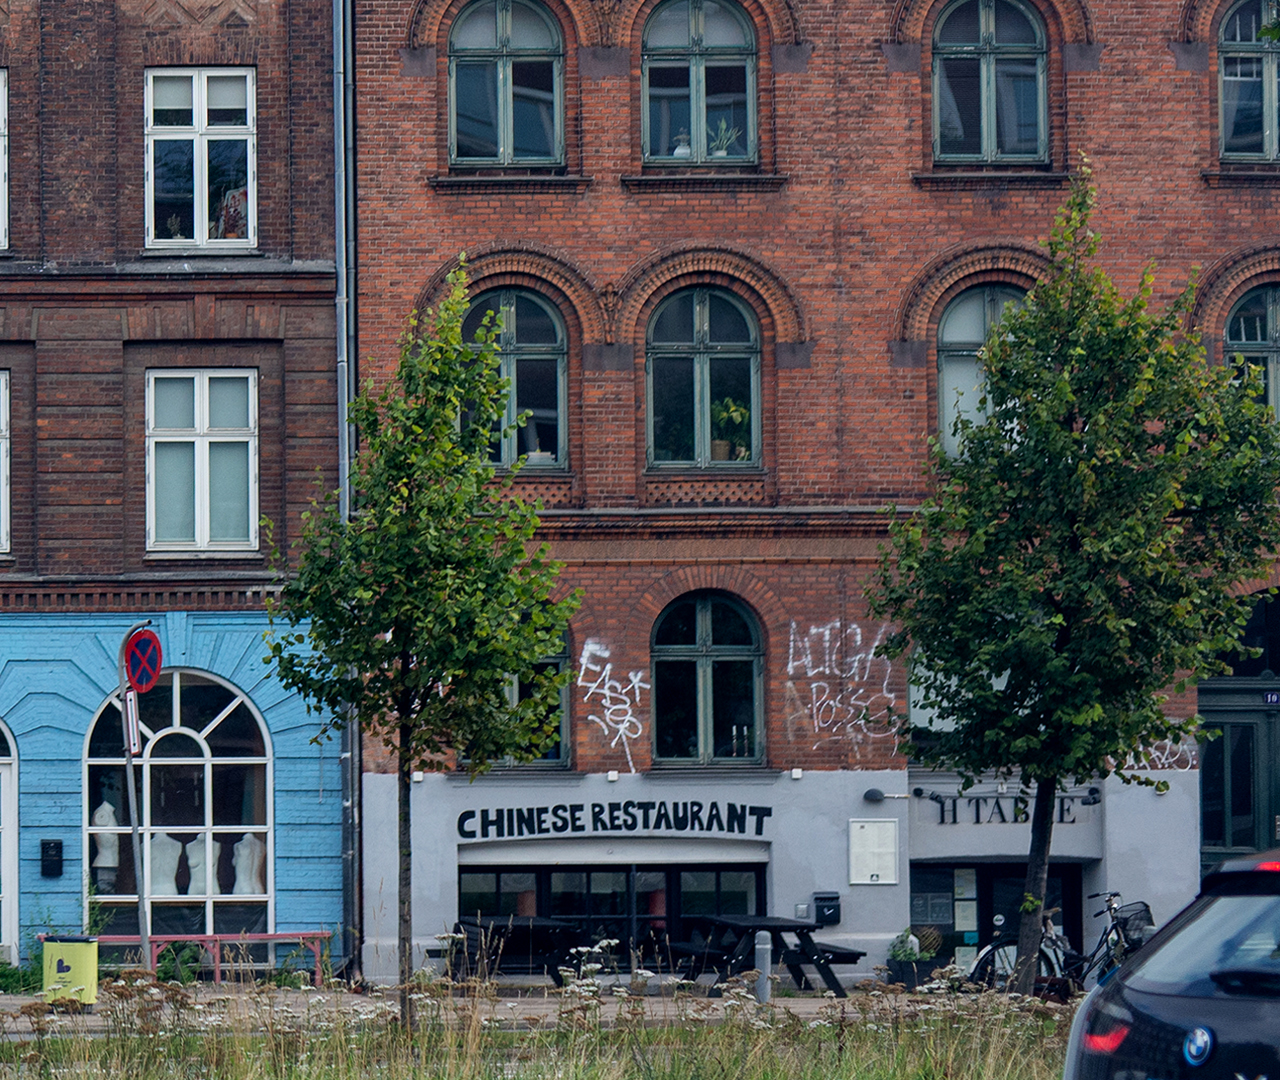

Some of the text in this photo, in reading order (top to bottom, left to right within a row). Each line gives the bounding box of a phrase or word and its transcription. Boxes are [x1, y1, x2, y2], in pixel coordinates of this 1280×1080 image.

[1267, 693, 1277, 703] 10
[457, 801, 773, 839] CHINESE RESTAURANT
[967, 797, 1076, 824] TABE
